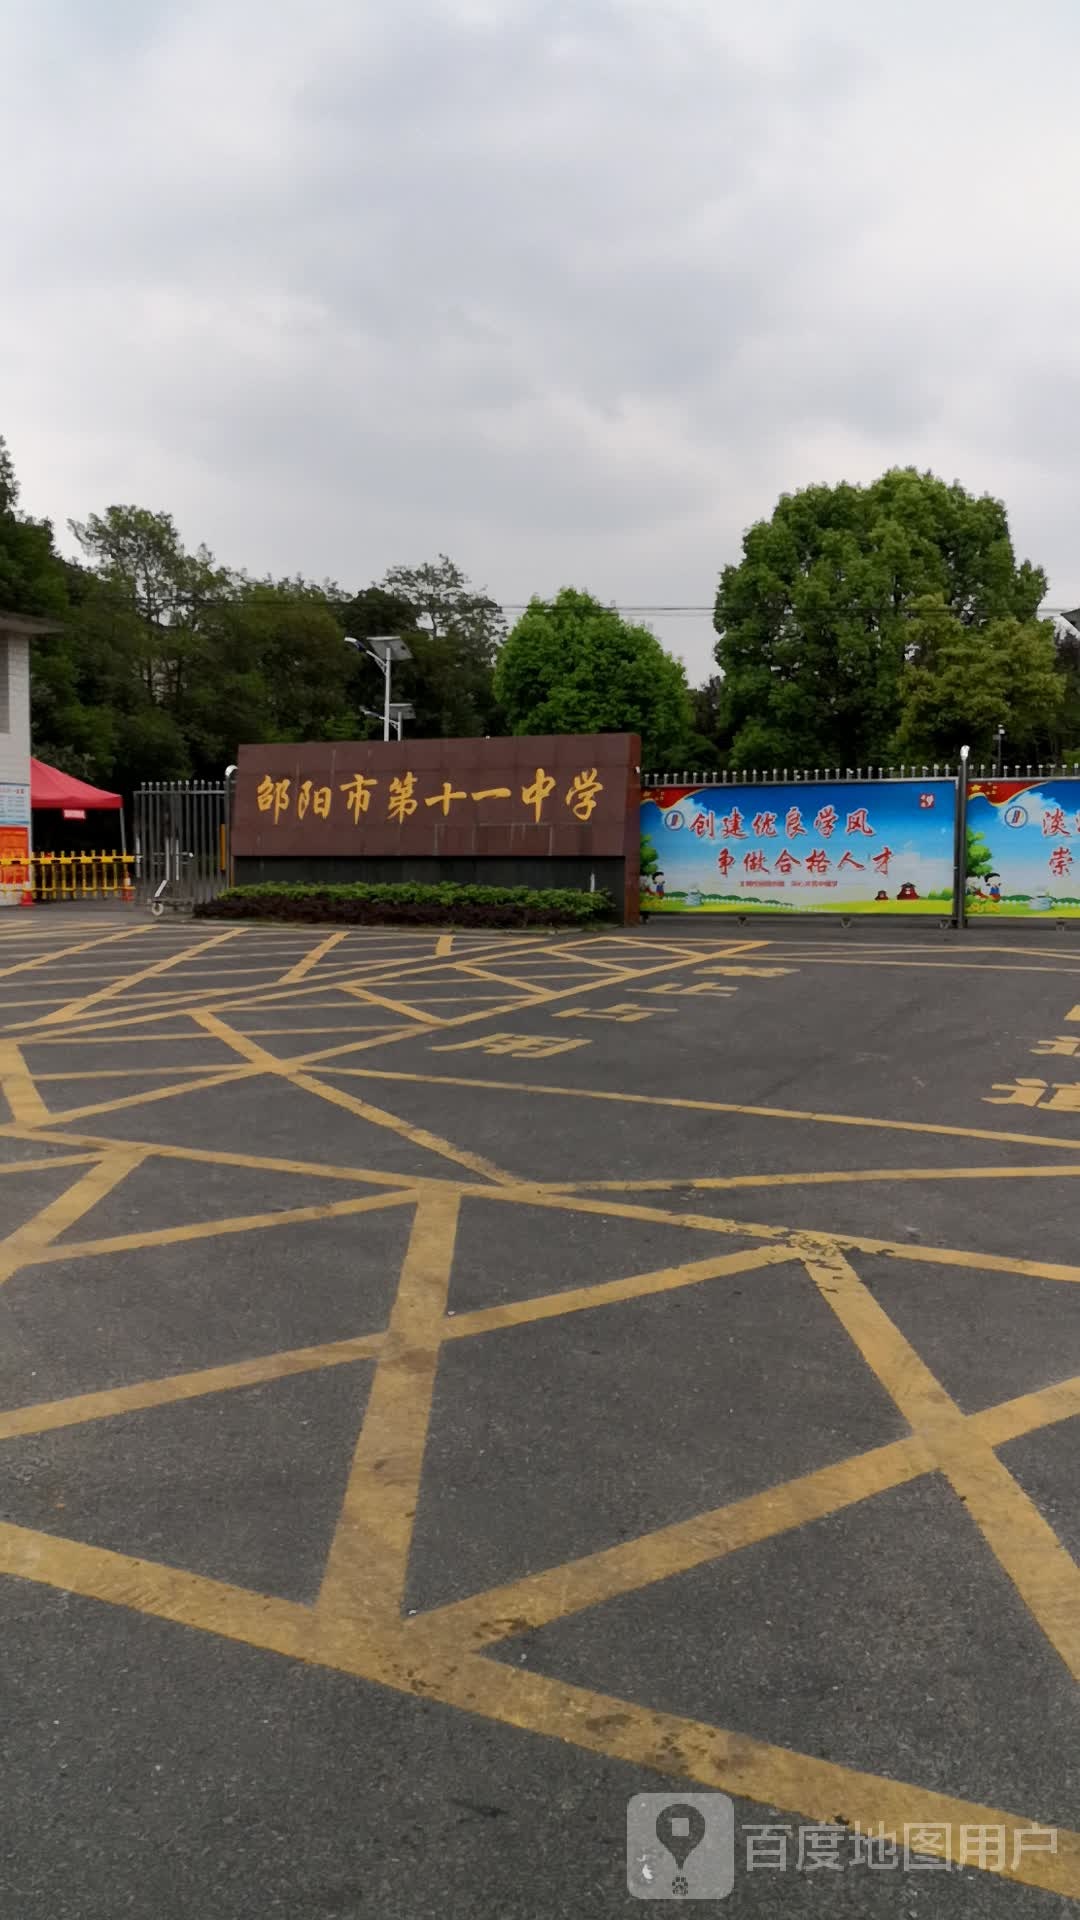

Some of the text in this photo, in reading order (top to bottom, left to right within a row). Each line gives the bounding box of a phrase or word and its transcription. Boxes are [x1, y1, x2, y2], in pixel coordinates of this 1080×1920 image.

[257, 768, 604, 824] 邵阳市第十一中学
[689, 804, 875, 838] 创建优良学风
[1043, 807, 1080, 837] 淡
[717, 847, 894, 876] 争做合格人才
